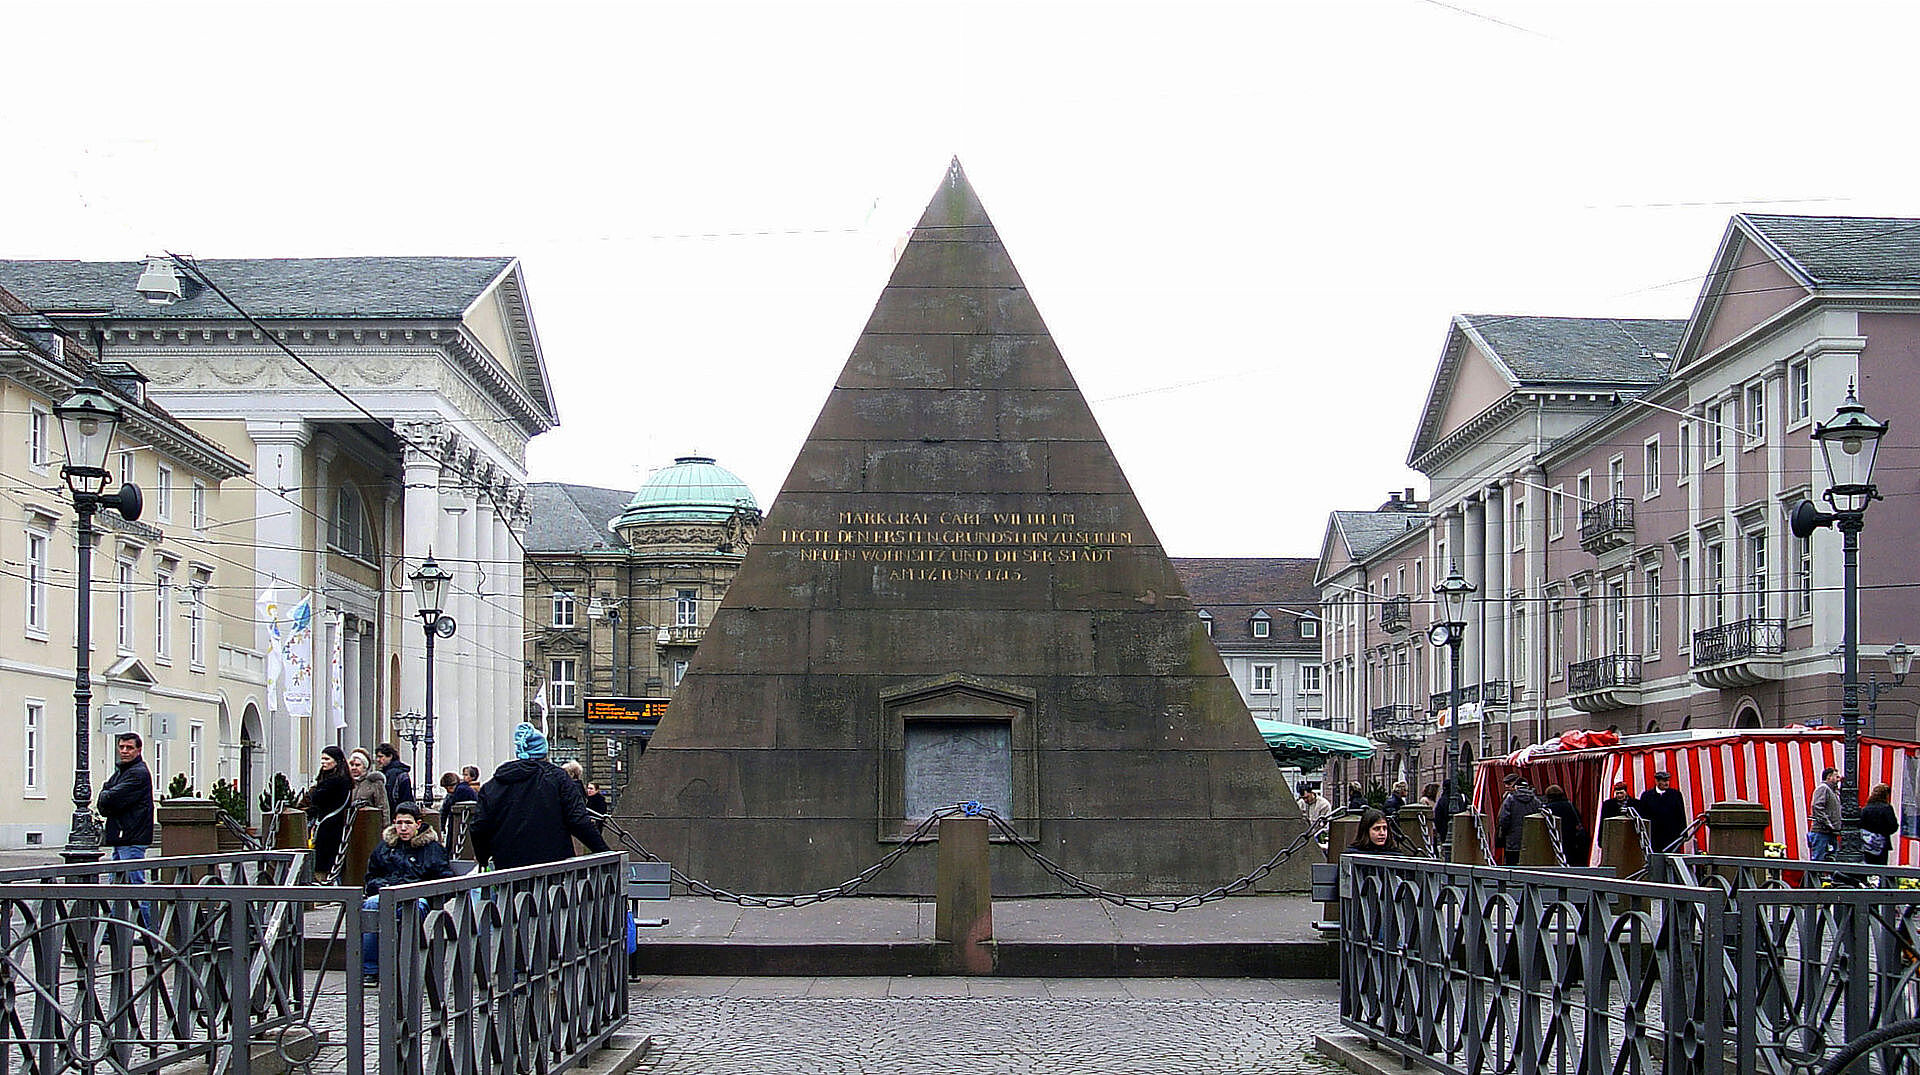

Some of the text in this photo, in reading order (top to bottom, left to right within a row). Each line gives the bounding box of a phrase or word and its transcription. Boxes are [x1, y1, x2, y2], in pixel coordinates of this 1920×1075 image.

[839, 512, 1075, 526] MARKGRAF CARL WILHELM
[781, 530, 831, 543] LEGTE
[838, 530, 869, 543] DEN
[874, 530, 939, 543] ERSTEN
[943, 530, 1048, 544] GRUNDSTEIN
[801, 549, 1113, 562] NEUEN WOHNSITZ UND DIESER STADT
[889, 568, 914, 581] AM
